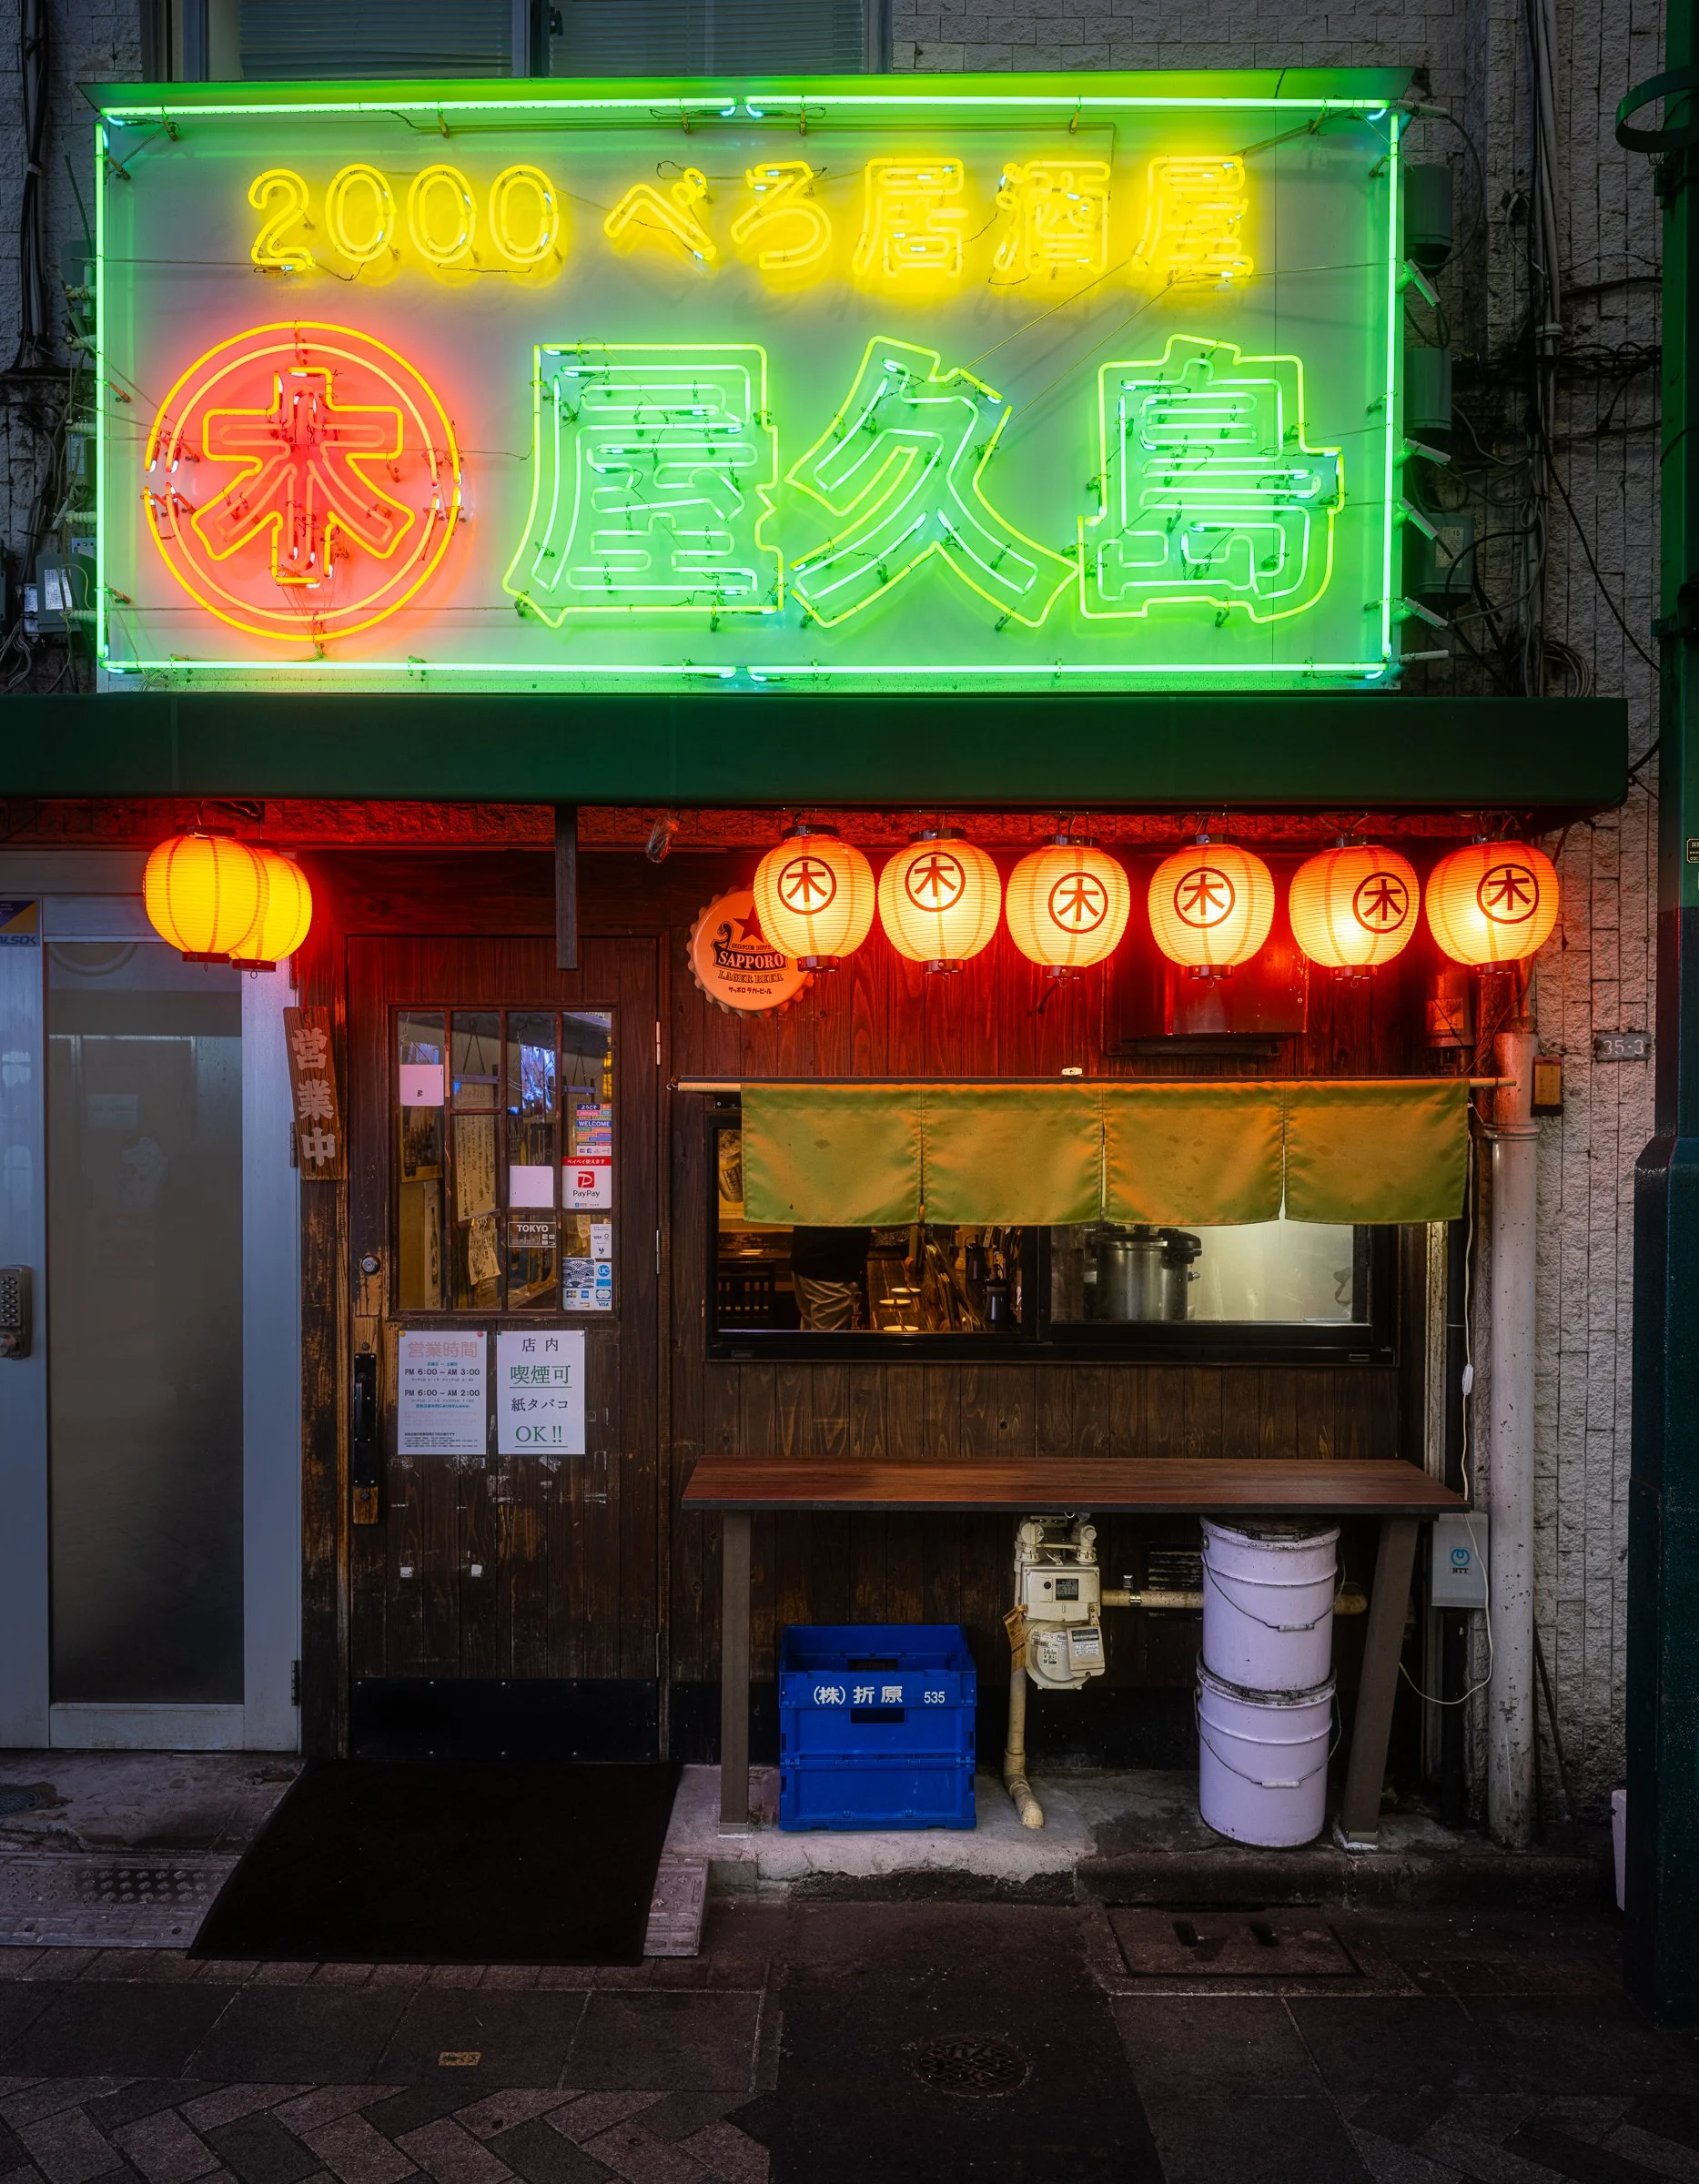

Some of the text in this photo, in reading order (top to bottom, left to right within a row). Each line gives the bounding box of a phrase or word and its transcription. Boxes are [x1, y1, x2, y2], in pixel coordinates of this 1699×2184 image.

[248, 163, 561, 275] 2000
[502, 334, 1345, 629] 屋久島
[786, 862, 827, 903] 木
[915, 856, 956, 897] 木
[1183, 874, 1225, 916] 木
[1487, 869, 1533, 911] 木
[1057, 879, 1100, 922] 木
[1362, 878, 1403, 921] 木
[718, 951, 784, 969] SAPPORO
[718, 970, 784, 983] LAGER BEER
[291, 1026, 336, 1167] 営業中
[572, 1189, 600, 1198] PayPay
[517, 1224, 549, 1232] TOKYO
[408, 1341, 478, 1359] 営業時間
[521, 1338, 559, 1352] 店内
[404, 1368, 415, 1376] PM
[418, 1368, 437, 1376] 6:00
[447, 1368, 458, 1376] AM
[460, 1368, 480, 1376] 3:00
[510, 1365, 571, 1384] 喫煙可
[418, 1389, 437, 1397] 6:00
[460, 1389, 480, 1397] 2:00
[511, 1398, 569, 1412] 紙タバコ
[924, 1691, 946, 1704] 535
